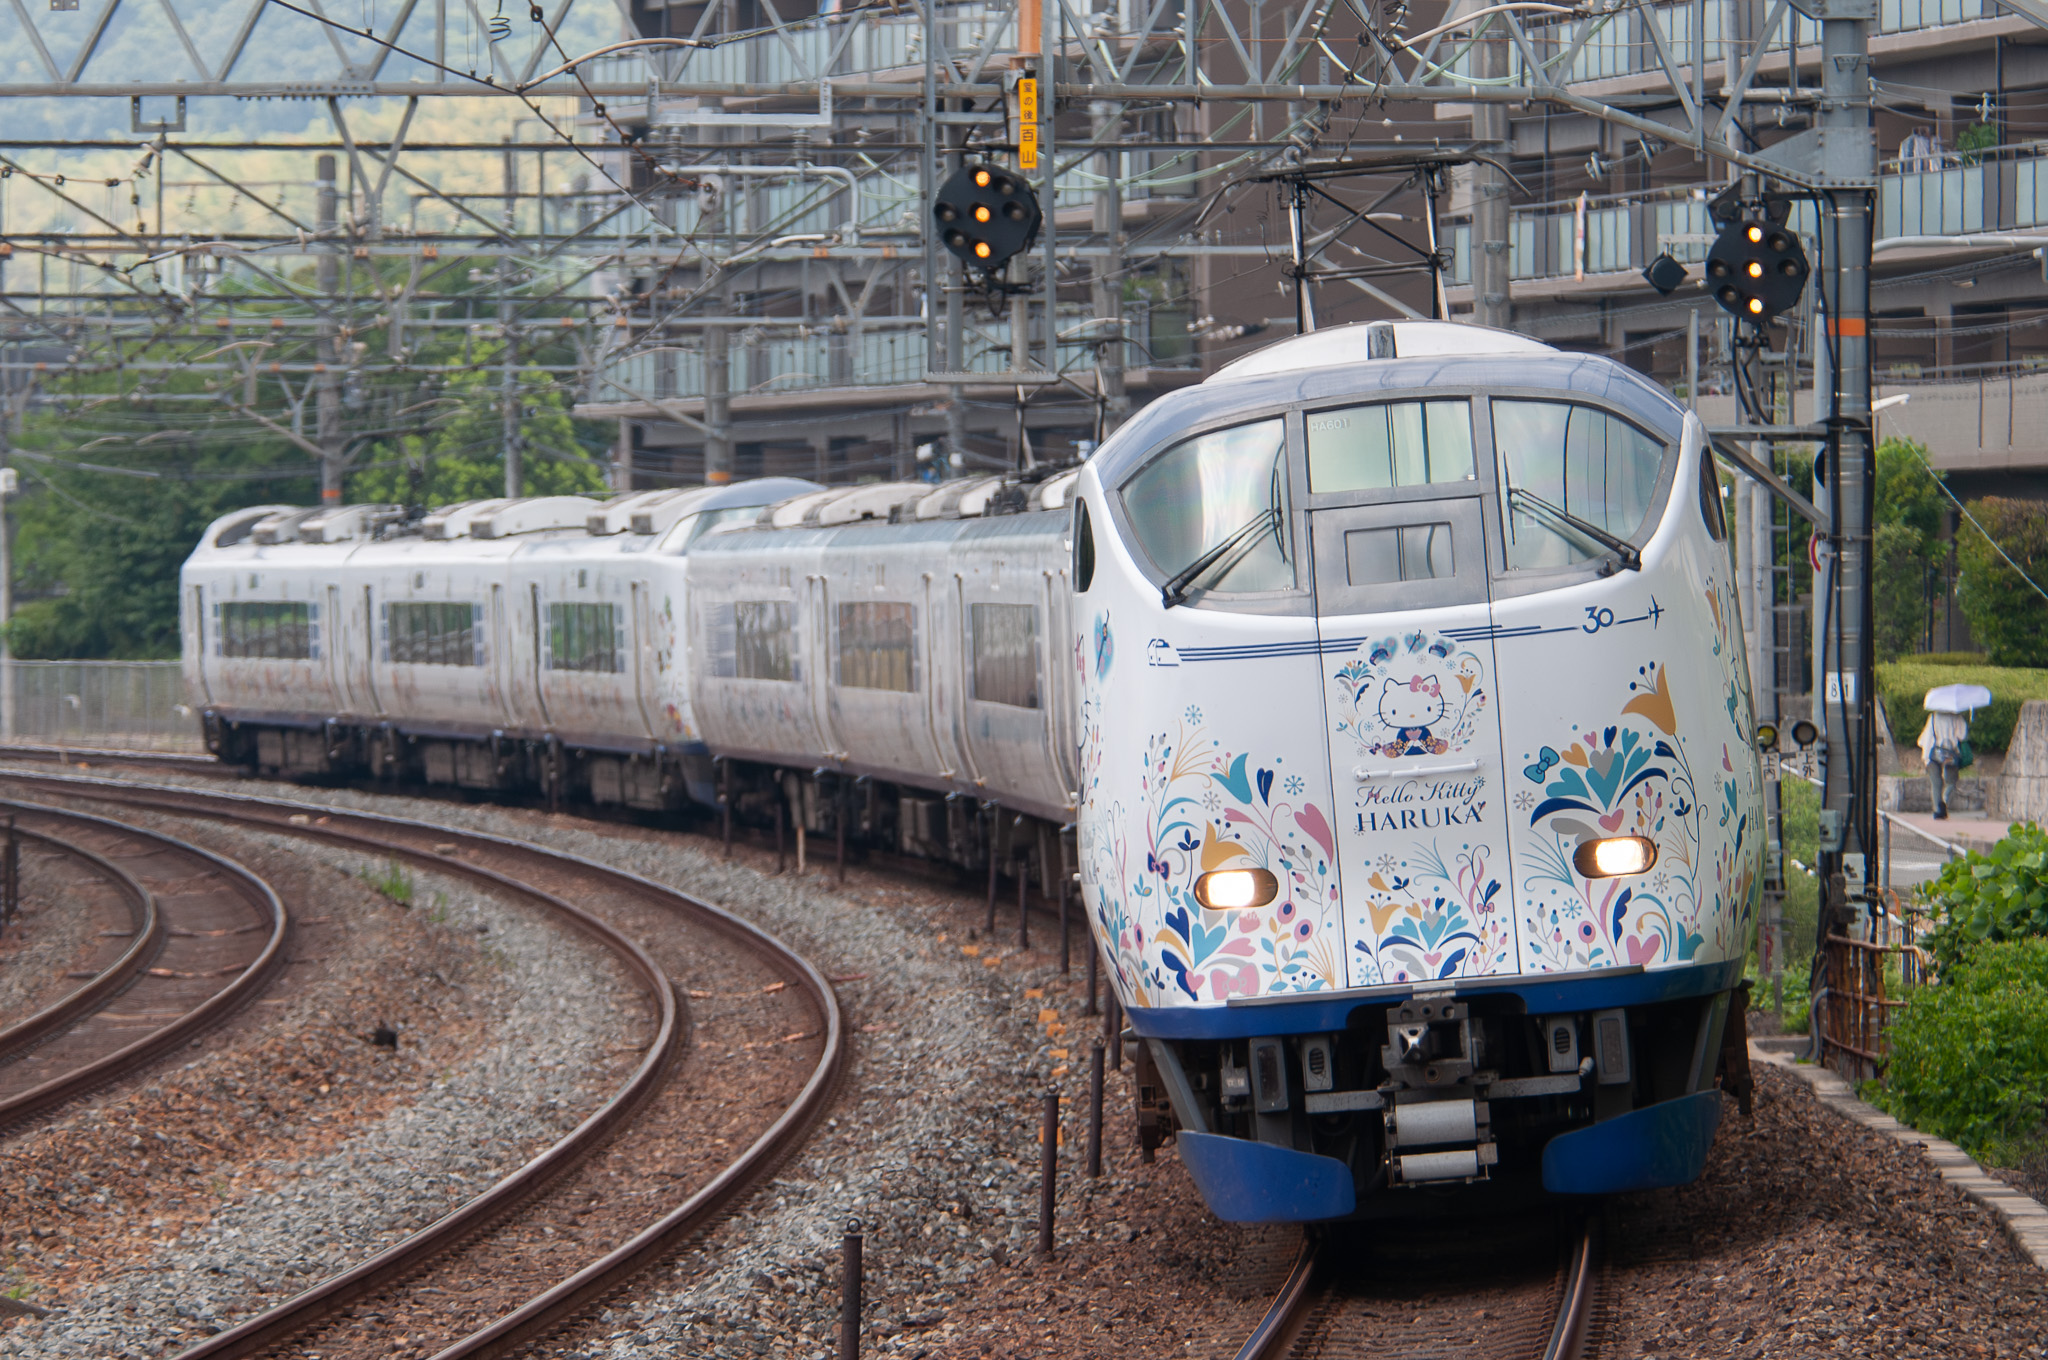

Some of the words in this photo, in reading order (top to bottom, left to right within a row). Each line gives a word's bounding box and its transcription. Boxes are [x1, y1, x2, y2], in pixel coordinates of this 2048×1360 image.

[1022, 128, 1035, 164] 百山
[1311, 418, 1347, 431] HA601
[1582, 606, 1614, 634] 30
[1355, 780, 1418, 808] Hello
[1420, 780, 1482, 806] Kitty
[1357, 804, 1483, 832] HARUKA
